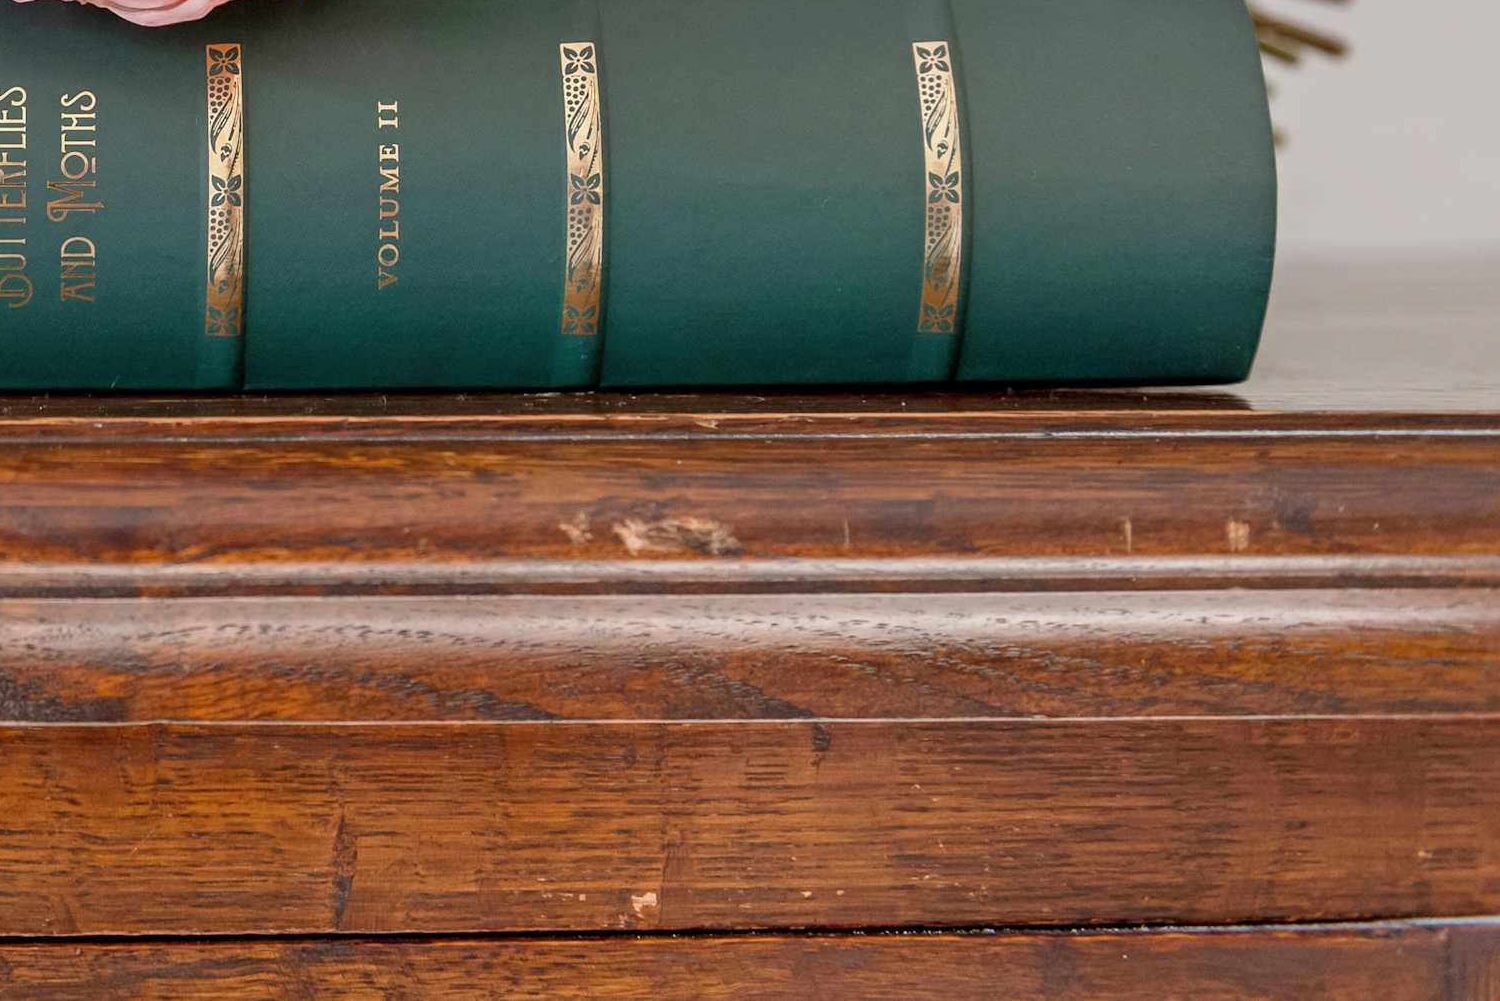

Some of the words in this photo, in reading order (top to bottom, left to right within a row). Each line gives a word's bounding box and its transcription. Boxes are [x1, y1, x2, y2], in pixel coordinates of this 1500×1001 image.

[46, 88, 106, 223] MOTHS
[377, 100, 399, 129] II
[376, 142, 401, 290] VOLUME
[59, 235, 97, 303] AND
